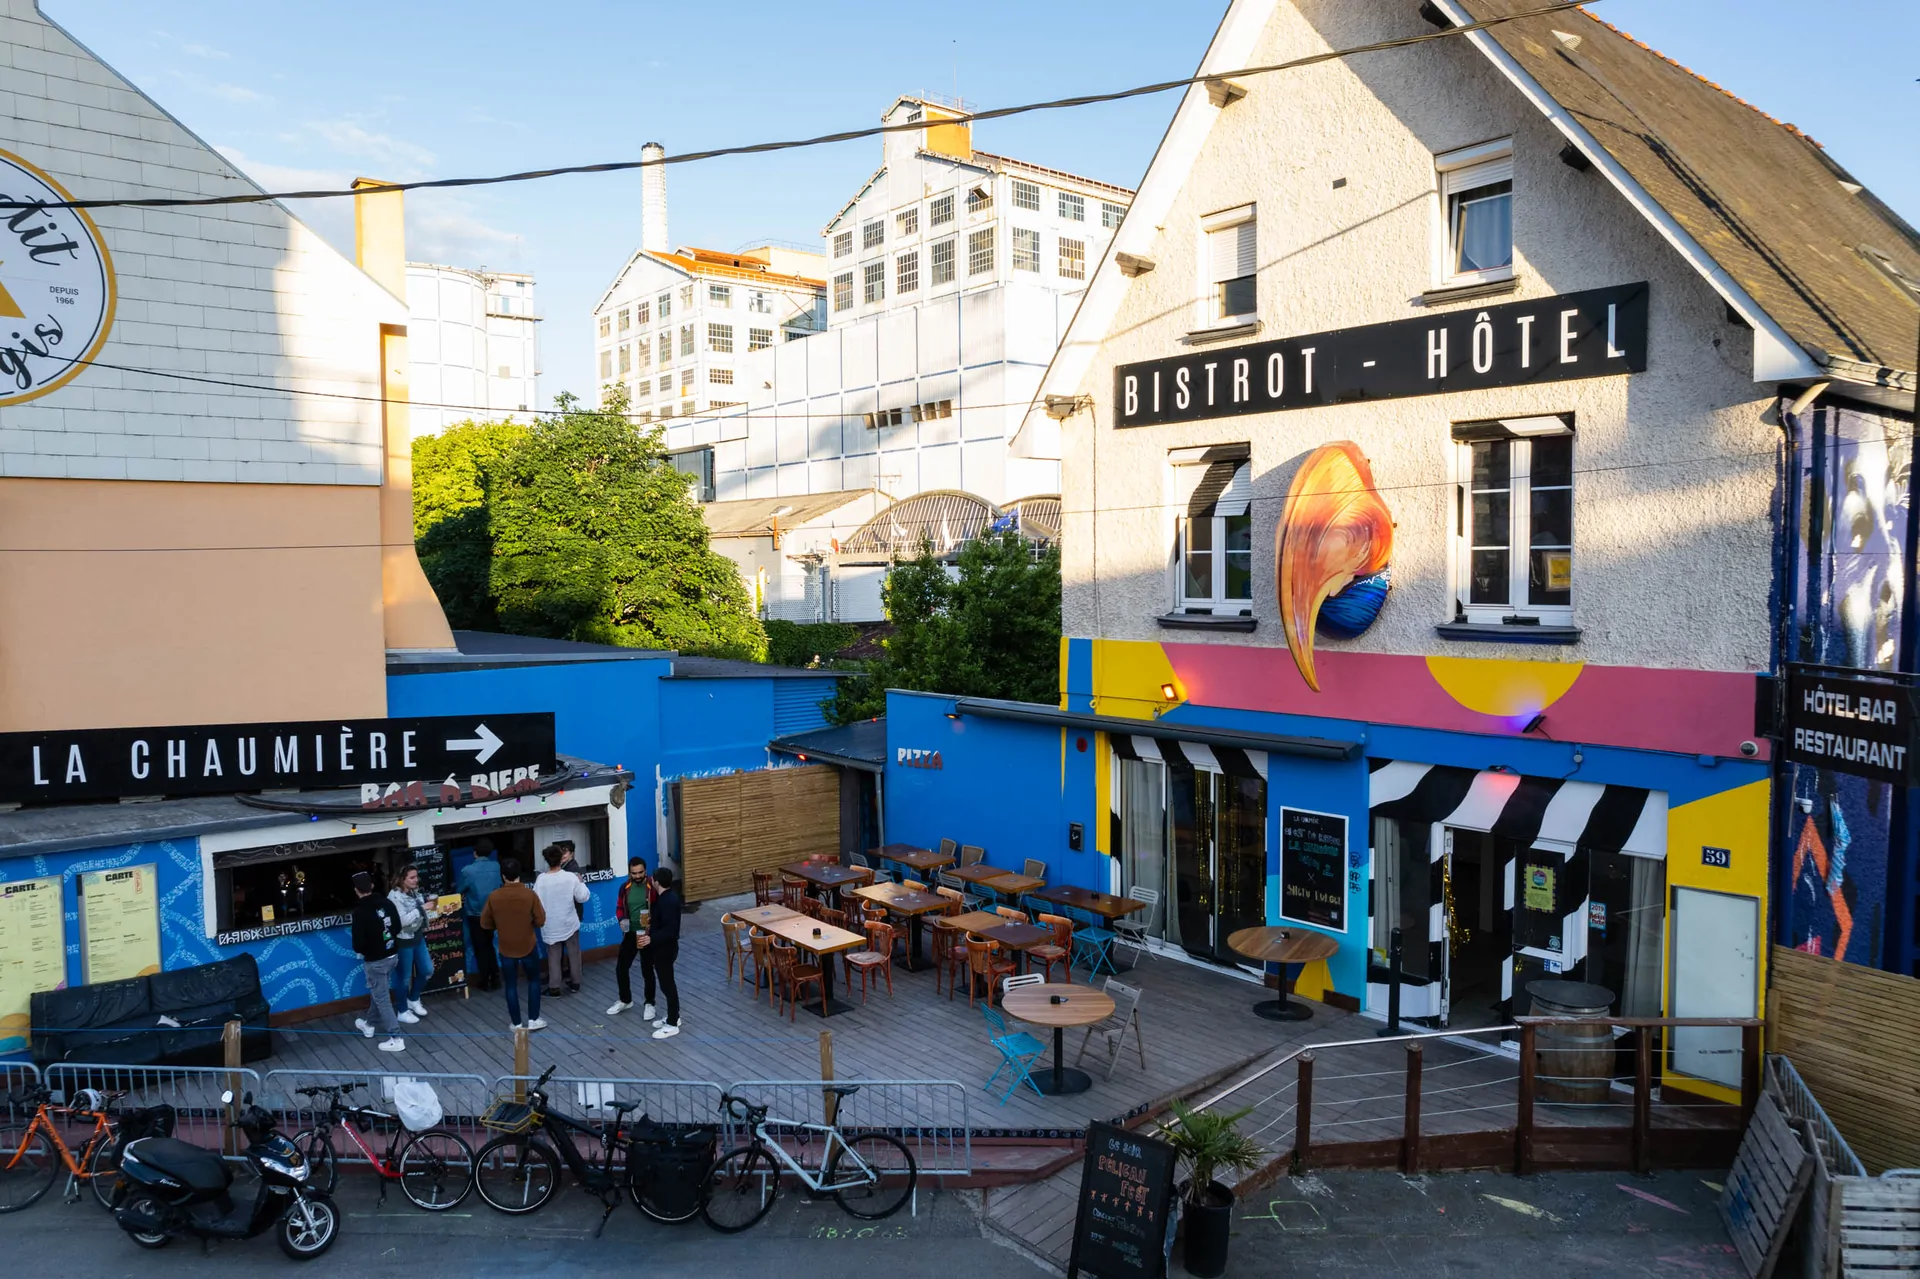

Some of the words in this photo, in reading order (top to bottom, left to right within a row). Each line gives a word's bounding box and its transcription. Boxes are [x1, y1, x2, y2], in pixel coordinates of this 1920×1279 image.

[49, 285, 79, 296] DEPUIS
[55, 296, 75, 305] 1966
[1124, 346, 1316, 417] BISTROT
[1427, 303, 1626, 379] HÔTEL
[32, 744, 88, 786] LA
[130, 726, 418, 780] CHAUMIÈRE
[1794, 727, 1906, 771] RESTAURANT
[897, 747, 943, 770] PIZZA
[361, 780, 429, 810] BAR
[273, 844, 292, 857] CB
[1704, 850, 1726, 865] 59
[105, 870, 134, 882] CARTE
[5, 883, 36, 895] CARTE
